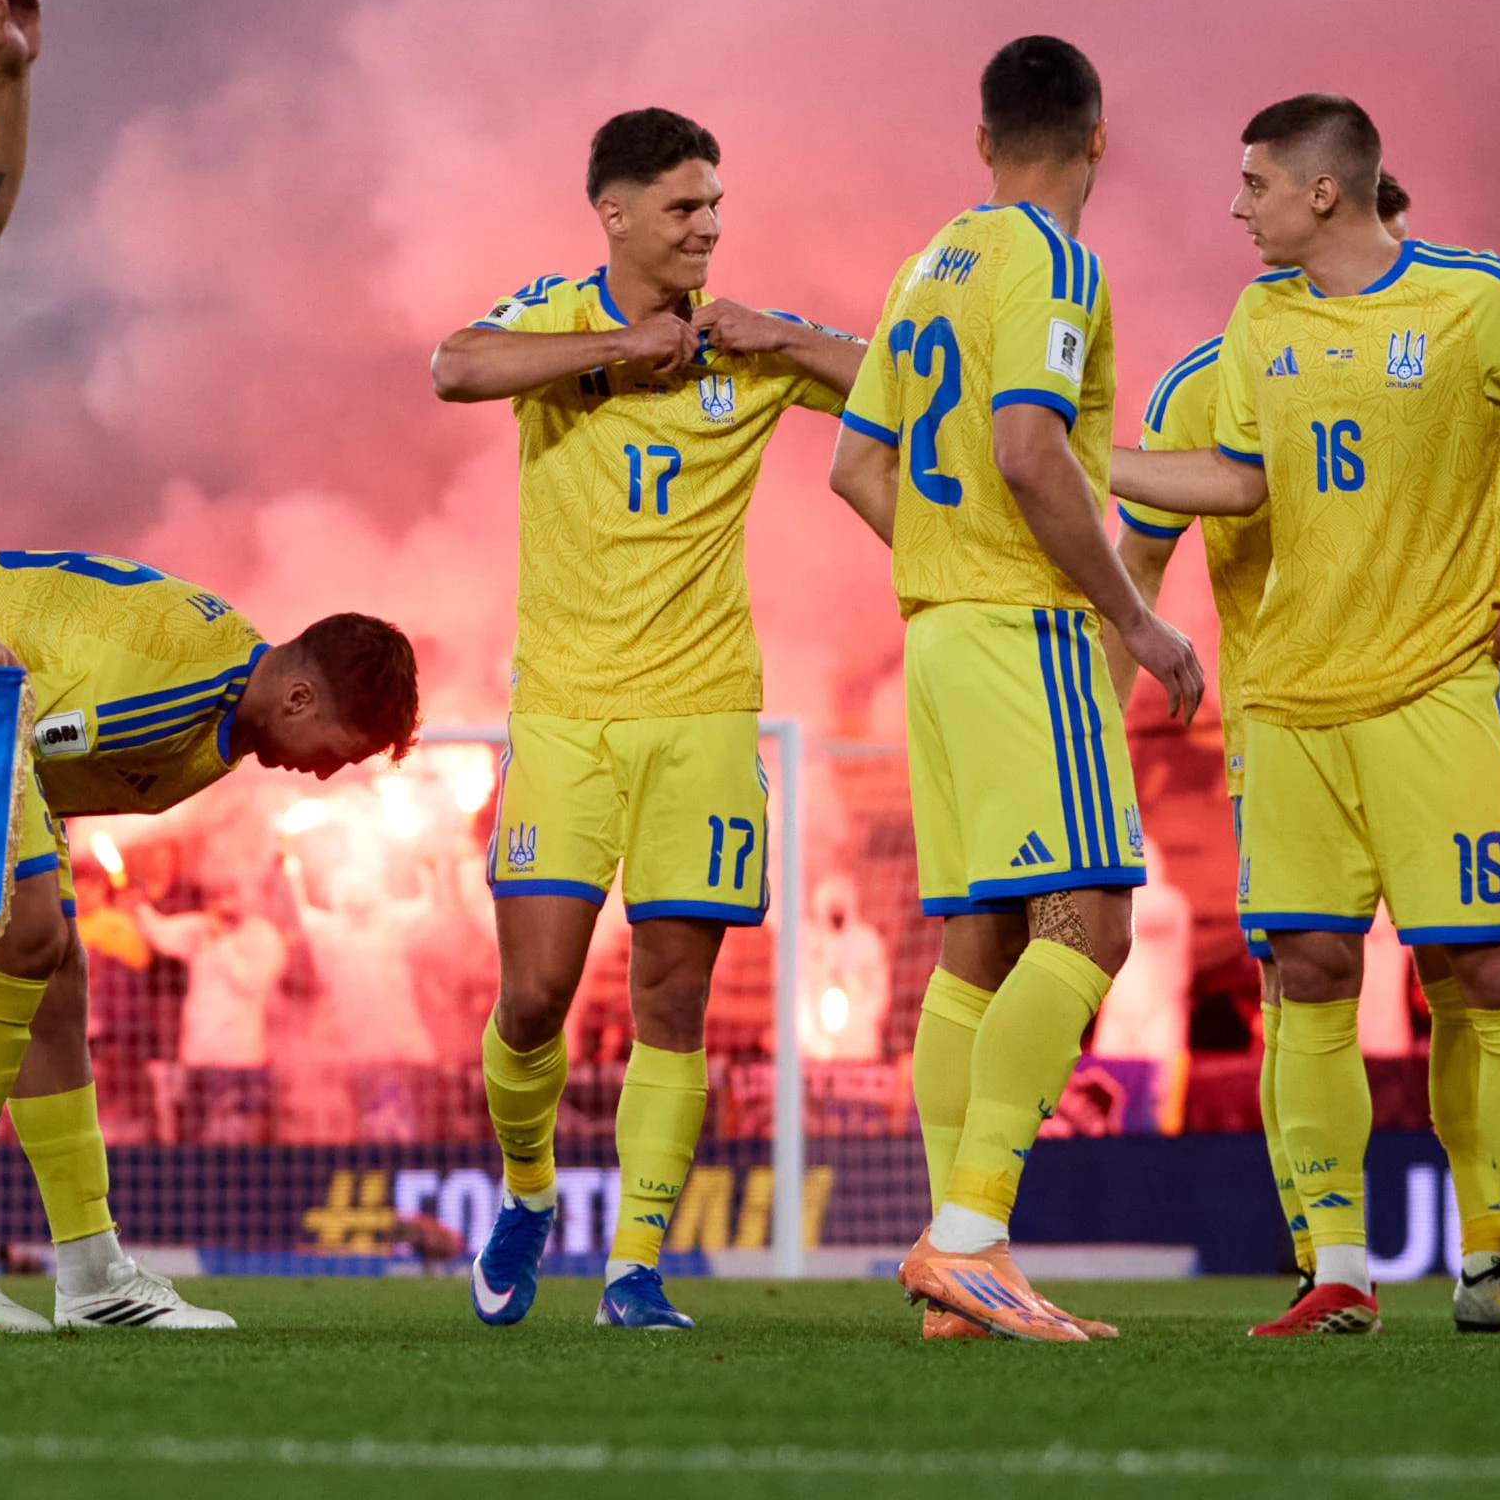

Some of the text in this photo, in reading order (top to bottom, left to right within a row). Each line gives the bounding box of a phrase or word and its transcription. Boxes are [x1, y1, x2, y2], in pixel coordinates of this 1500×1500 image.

[624, 444, 682, 515] 17
[1311, 419, 1365, 493] 16
[708, 814, 755, 890] 17
[639, 1177, 681, 1195] UAF
[1295, 1157, 1338, 1175] UAF
